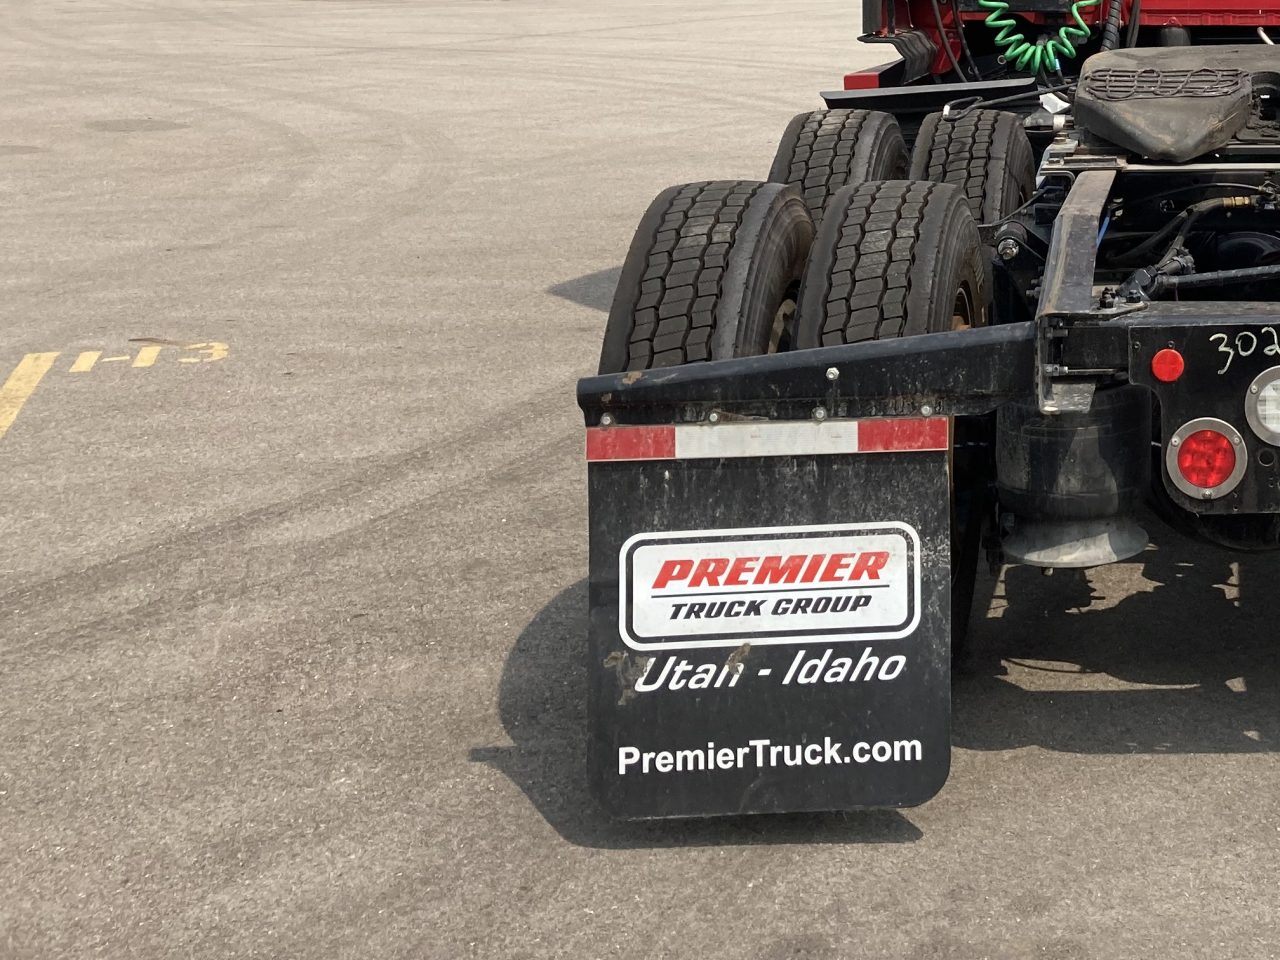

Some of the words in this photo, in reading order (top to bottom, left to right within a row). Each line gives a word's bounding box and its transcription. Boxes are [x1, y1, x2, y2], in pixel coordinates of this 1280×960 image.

[651, 550, 890, 590] PREMIER
[669, 599, 768, 620] TRUCK
[771, 594, 873, 617] GROUP
[634, 654, 745, 693] Utah
[781, 646, 908, 685] Idaho
[618, 736, 923, 775] PremierTruck.com
